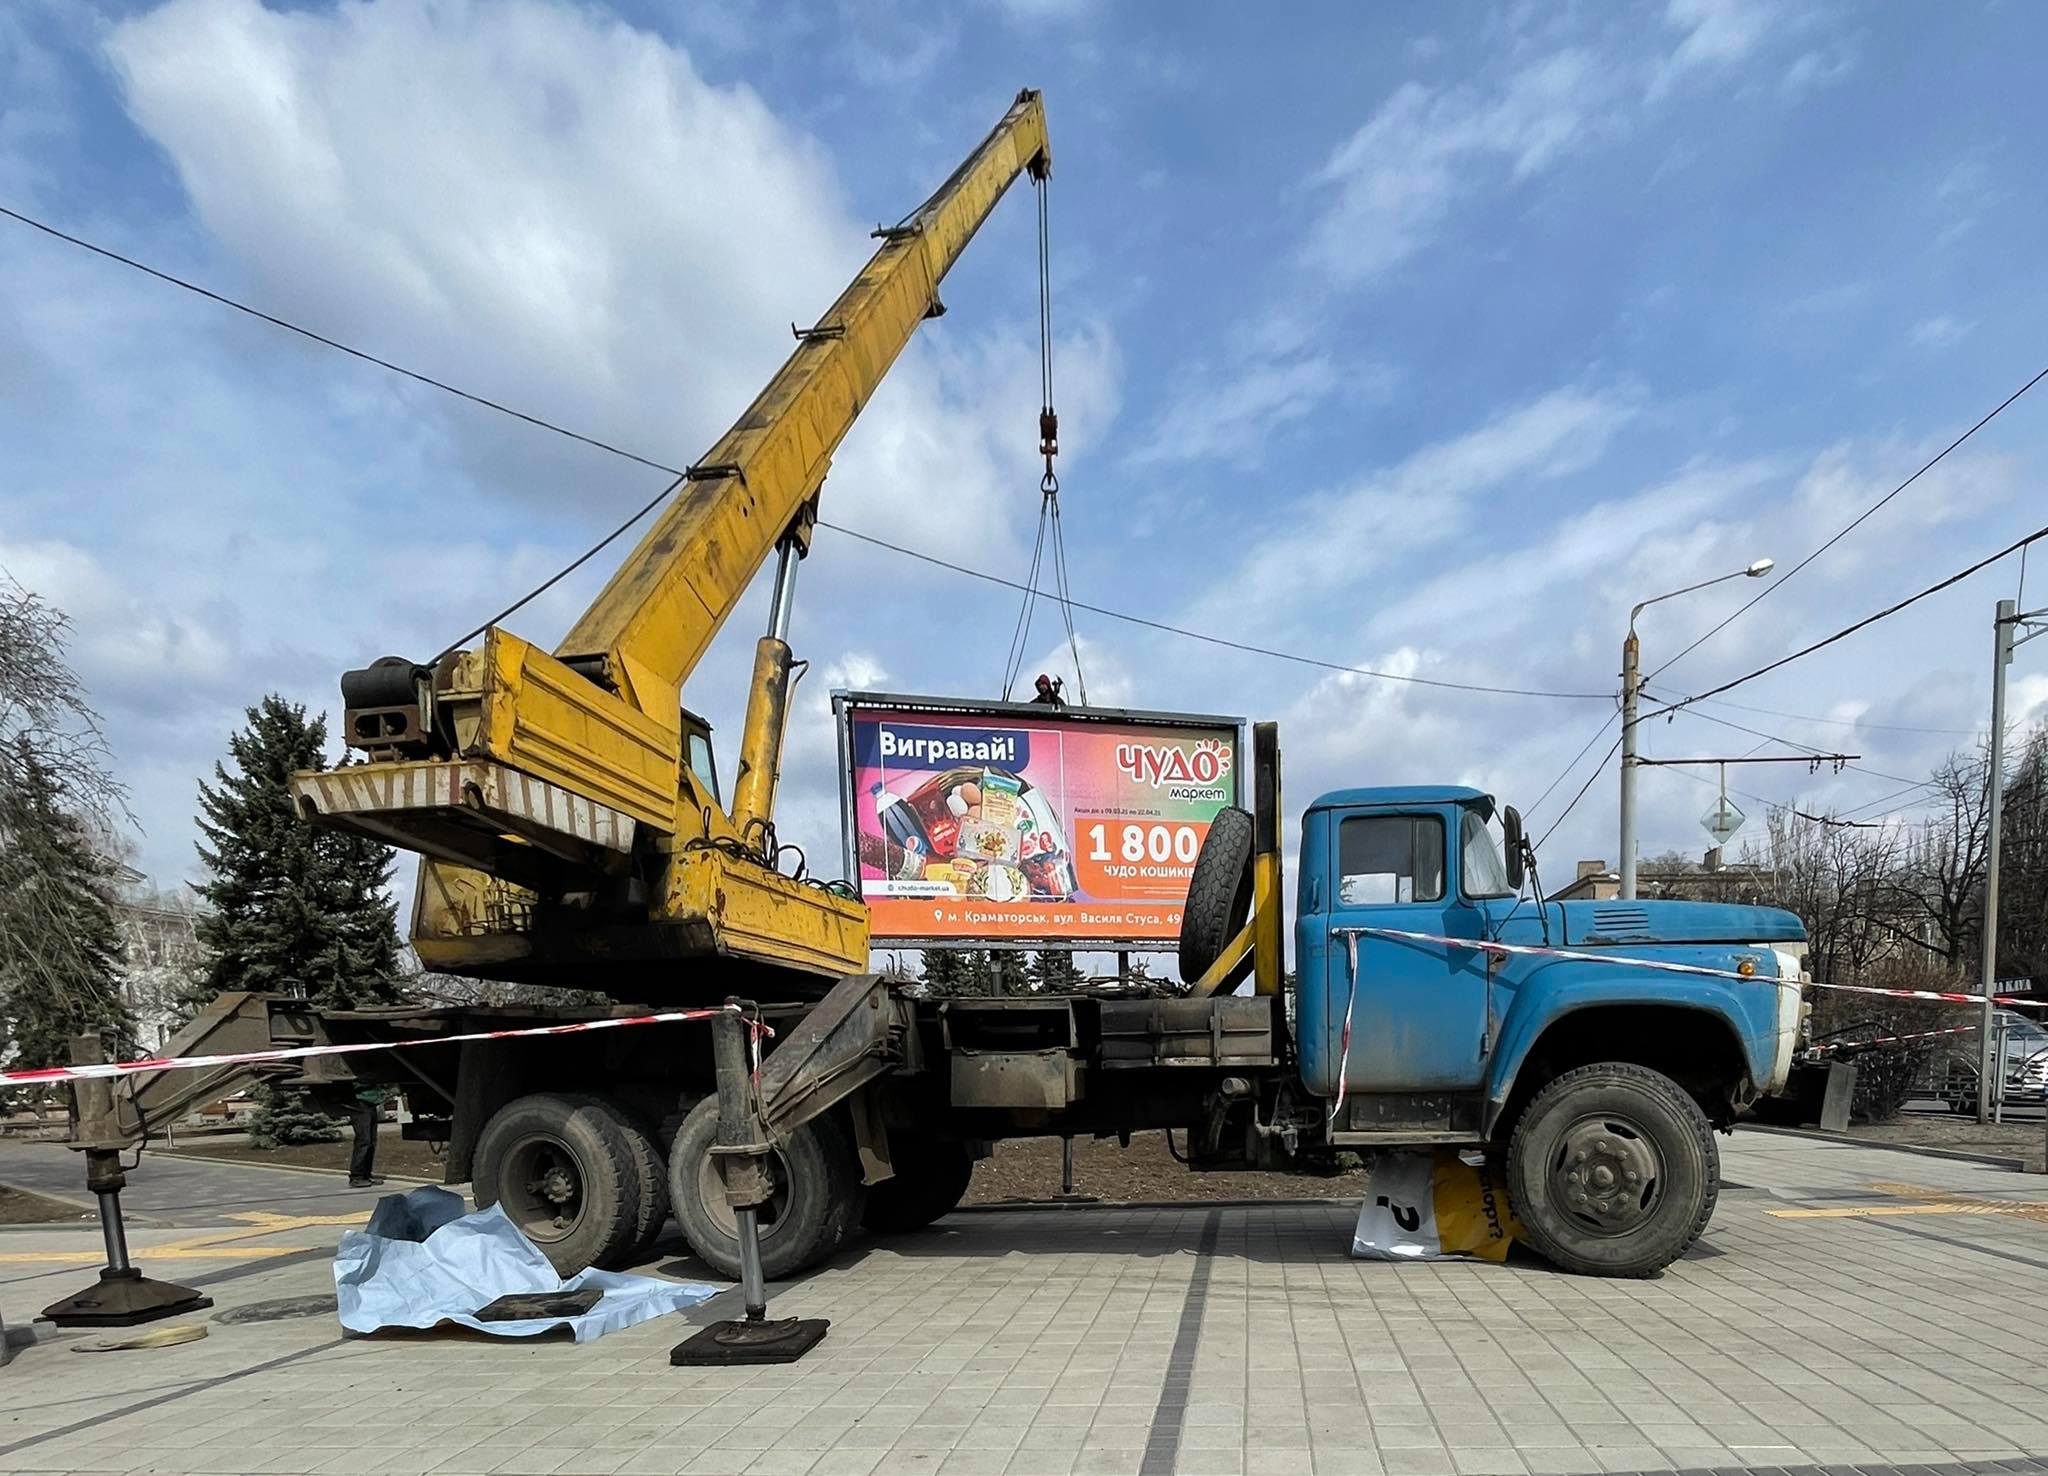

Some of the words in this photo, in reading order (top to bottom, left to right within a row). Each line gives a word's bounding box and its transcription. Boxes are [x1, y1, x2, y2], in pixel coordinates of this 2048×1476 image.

[880, 731, 1015, 764] Вигравай!
[1118, 746, 1220, 785] ЧУДО
[1169, 788, 1226, 803] маркет
[1104, 865, 1137, 878] ЧУДО
[947, 913, 961, 923] м.
[965, 911, 1050, 925] Краматорськ,
[1053, 913, 1077, 925] вул.
[1080, 912, 1122, 924] Василя
[1125, 912, 1163, 926] Стуса,
